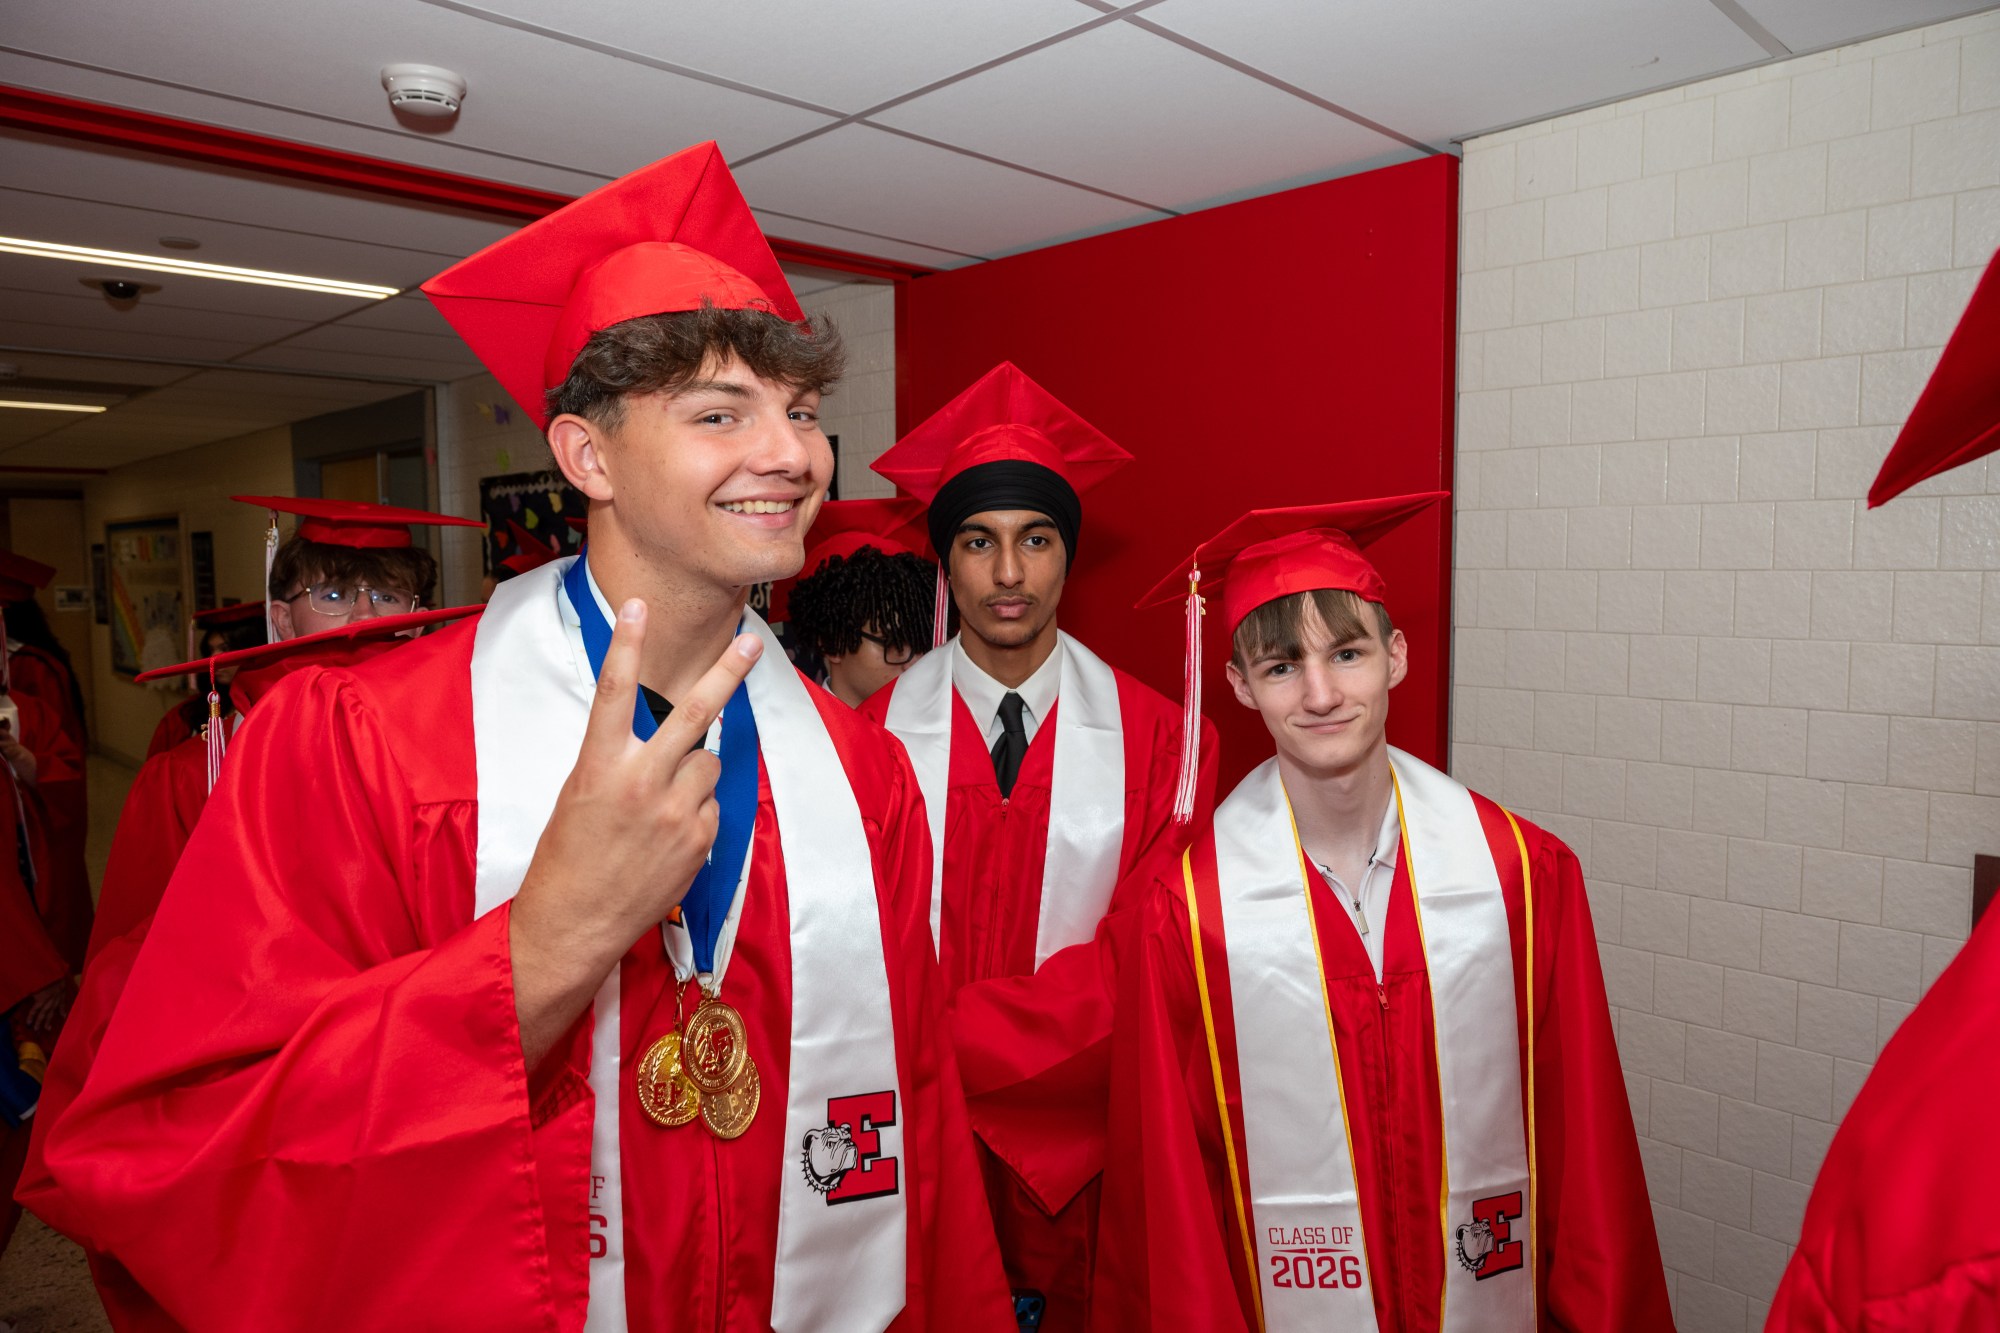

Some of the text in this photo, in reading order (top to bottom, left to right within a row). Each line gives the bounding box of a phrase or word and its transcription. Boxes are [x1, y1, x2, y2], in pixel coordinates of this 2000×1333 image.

[826, 1090, 899, 1206] E
[591, 1176, 605, 1199] F
[1268, 1226, 1354, 1245] CLASS OF
[1472, 1190, 1523, 1281] E
[1270, 1255, 1362, 1289] 2026
